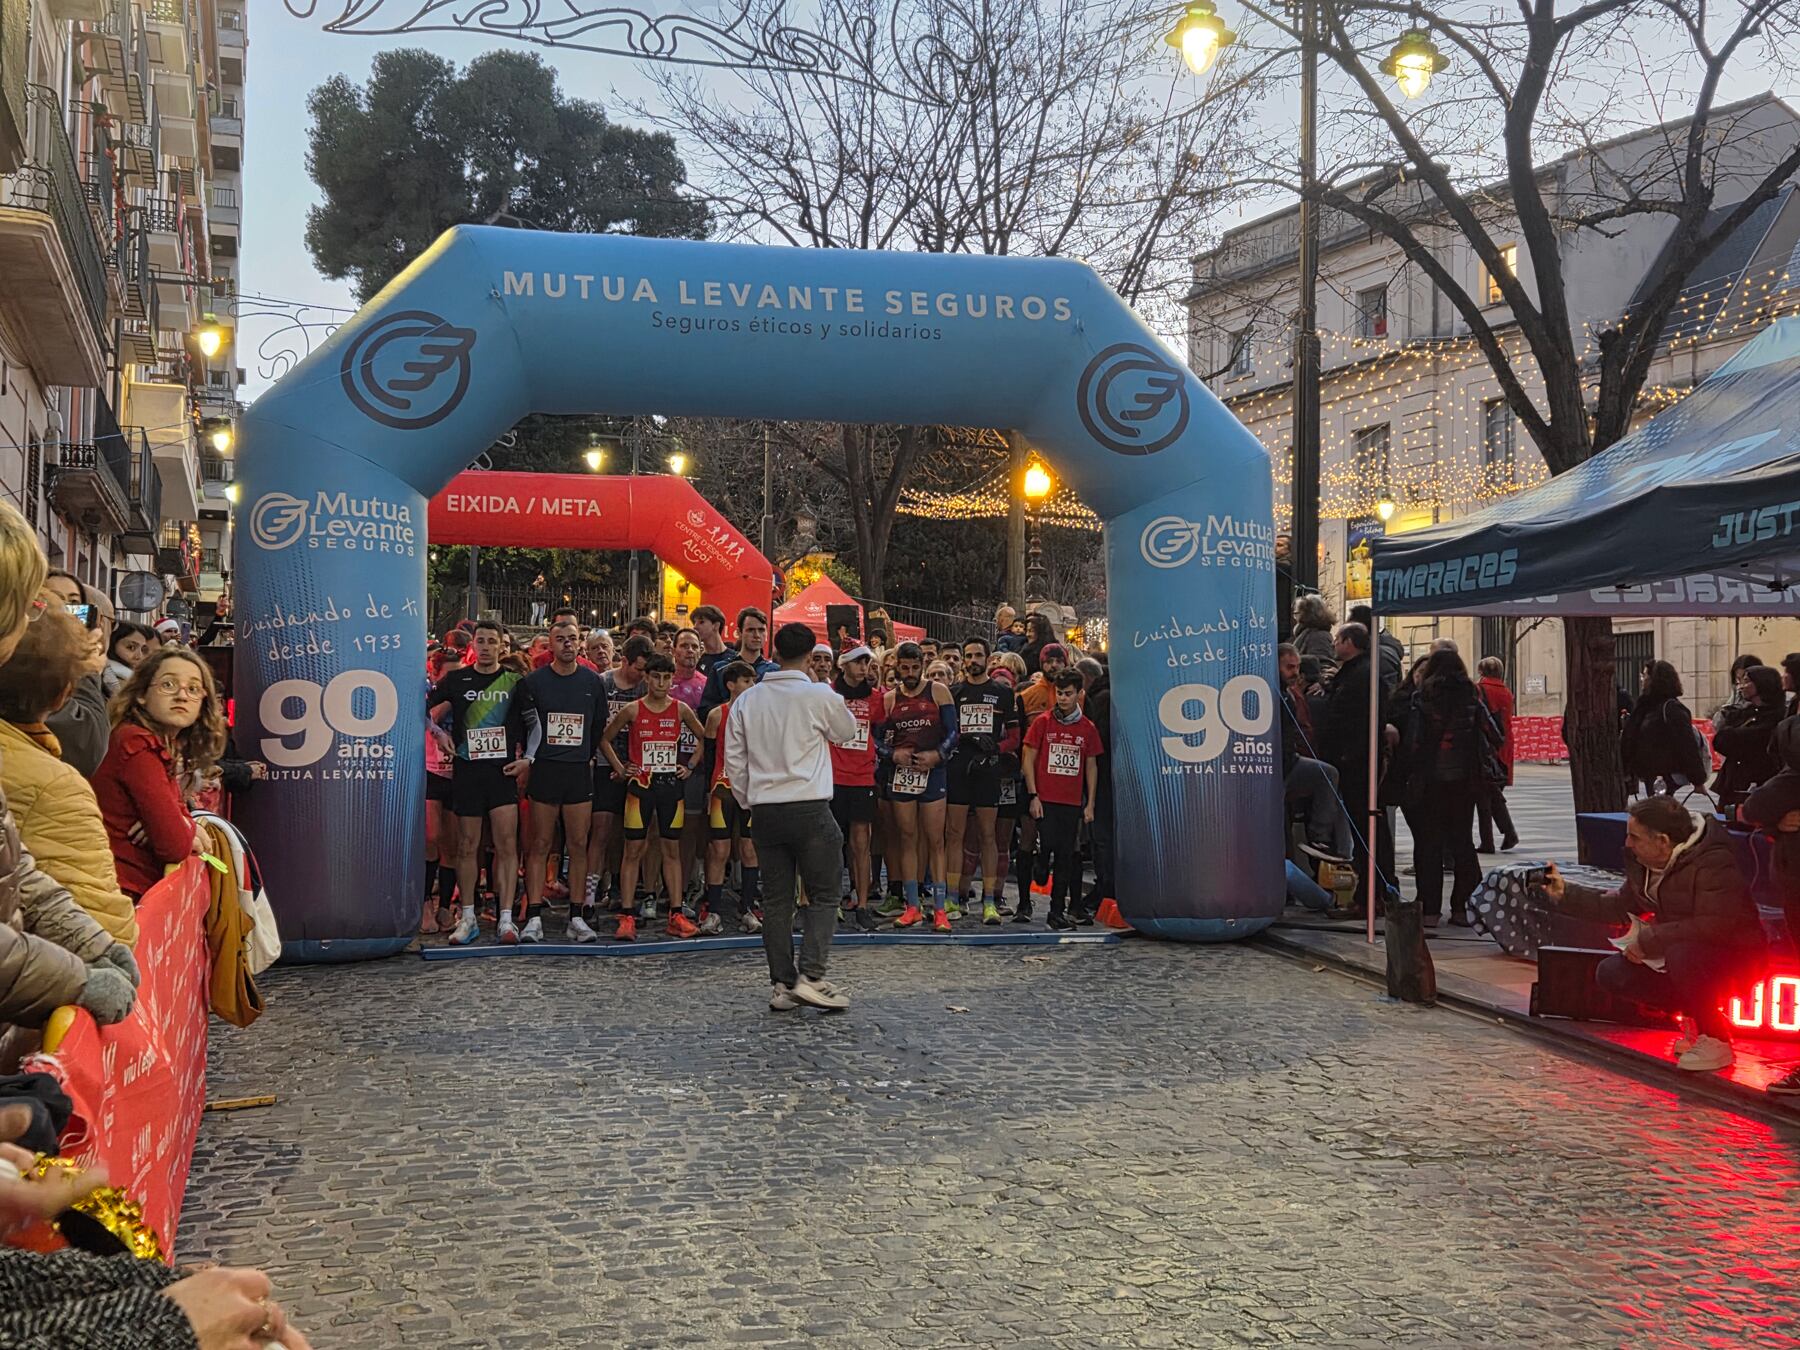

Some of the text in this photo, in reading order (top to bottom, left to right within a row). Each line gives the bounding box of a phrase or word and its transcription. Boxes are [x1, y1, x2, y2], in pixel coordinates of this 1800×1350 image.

[503, 270, 1073, 322] MUTUA LEVANTE SEGUROS
[651, 311, 943, 342] Seguros éticos y solidarios
[313, 491, 412, 524] Mutua
[446, 493, 521, 514] EIXIDA
[541, 497, 602, 517] META
[309, 515, 415, 545] Levante
[675, 521, 703, 543] CENTRE
[1205, 515, 1275, 543] Mutua
[1712, 501, 1800, 549] JUST
[308, 537, 415, 557] SEGUROS
[682, 539, 713, 564] Alcoi
[365, 592, 393, 619] de
[401, 597, 418, 617] ti
[1133, 608, 1239, 649] Cuidando
[1249, 606, 1267, 629] de
[268, 630, 401, 661] desde 1933
[1166, 639, 1273, 668] desde 1933
[463, 688, 509, 704] erum
[259, 669, 399, 768] 90
[557, 723, 574, 736] 26
[965, 713, 988, 725] 715
[1158, 674, 1274, 763] 90
[337, 738, 394, 759] años
[475, 737, 500, 751] 310
[1232, 736, 1273, 755] años
[648, 751, 671, 765] 151
[1054, 753, 1076, 767] 303
[1161, 764, 1274, 776] MUTUA LEVANTE
[322, 769, 395, 780] LEVANTE
[899, 774, 922, 786] 391
